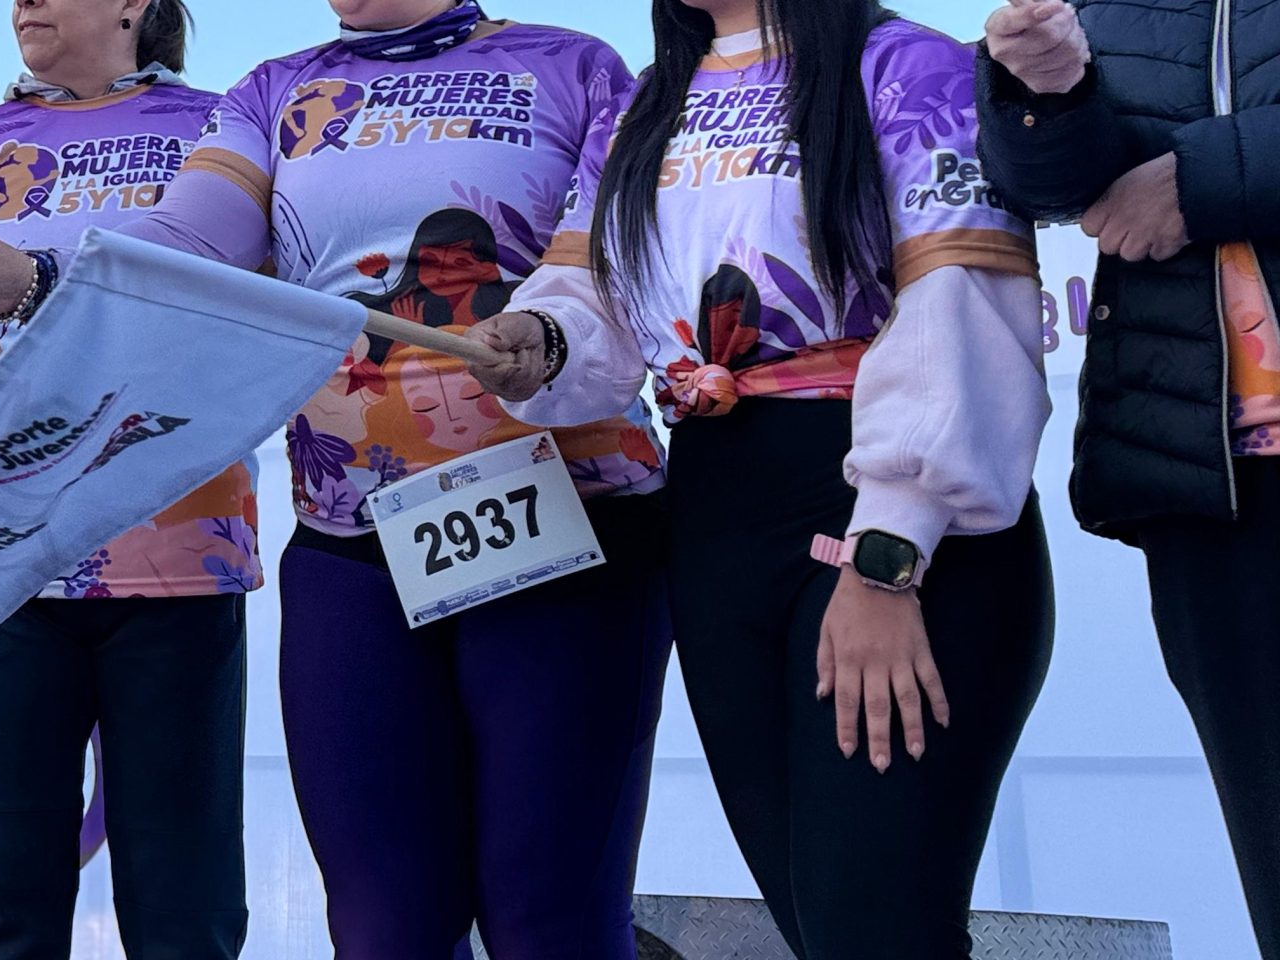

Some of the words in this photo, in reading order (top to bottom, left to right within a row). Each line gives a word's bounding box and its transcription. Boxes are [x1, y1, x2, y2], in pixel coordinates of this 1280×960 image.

[370, 72, 511, 91] CARRERA
[365, 87, 534, 109] MUJERES
[684, 87, 789, 113] CARRER
[363, 111, 375, 121] Y
[380, 110, 404, 121] LA
[410, 105, 531, 123] IGUALDAD
[681, 106, 789, 136] MUJER
[354, 122, 384, 148] 5
[392, 119, 419, 144] Y
[427, 117, 533, 148] 10km
[680, 138, 702, 155] LA
[706, 128, 785, 150] IGUALD
[61, 135, 182, 159] CARRERA
[61, 151, 192, 178] MUJERE
[657, 158, 686, 188] 5
[691, 151, 718, 188] Y
[60, 181, 72, 191] Y
[75, 178, 97, 190] LA
[103, 171, 175, 187] IGUALD
[56, 191, 81, 213] 5
[88, 188, 114, 210] Y
[118, 184, 165, 209] 10
[414, 484, 541, 576] 2937
